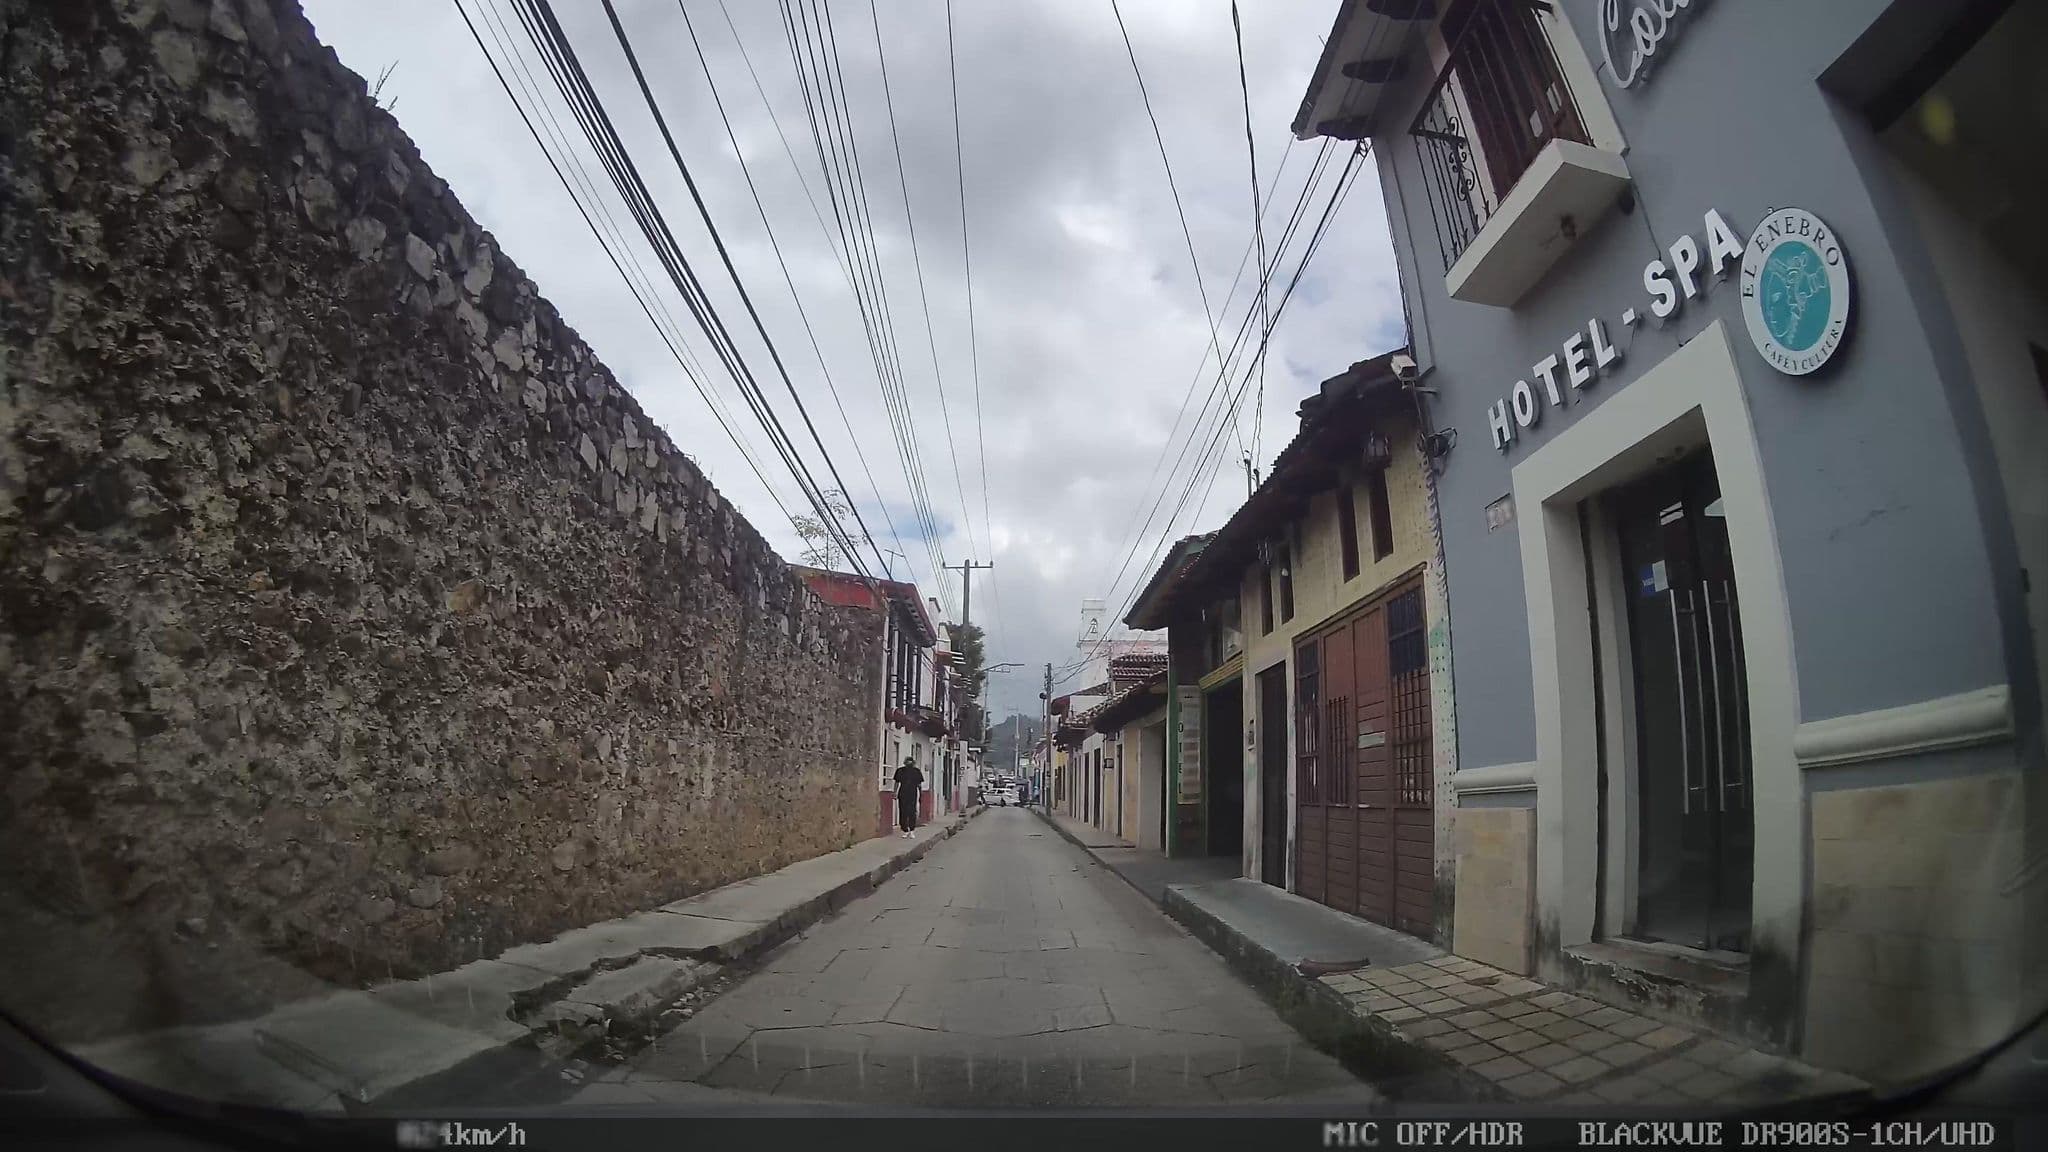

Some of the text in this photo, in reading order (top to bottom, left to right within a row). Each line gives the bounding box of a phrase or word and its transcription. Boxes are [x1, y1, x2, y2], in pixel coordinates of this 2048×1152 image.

[1486, 318, 1617, 452] HOTEL
[1642, 207, 1744, 319] SPA
[1743, 216, 1840, 299] EL ENEBRO
